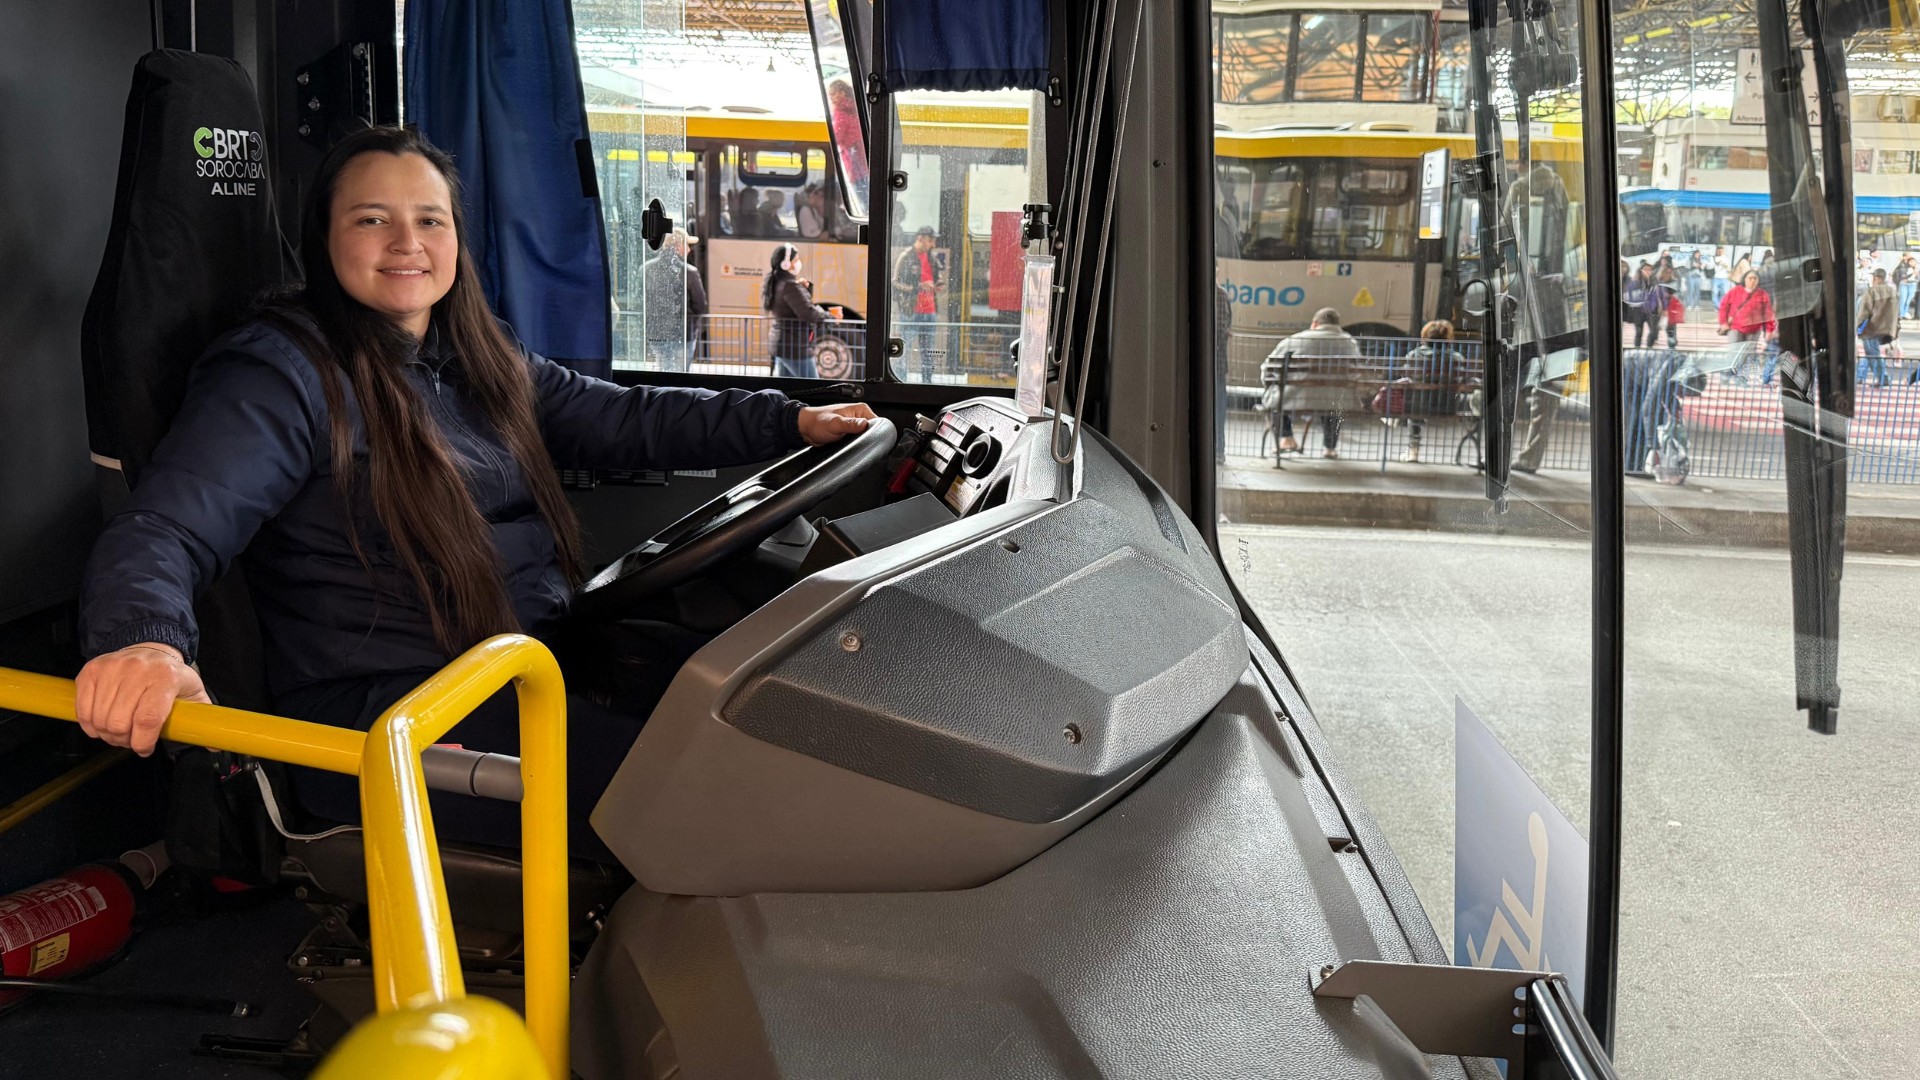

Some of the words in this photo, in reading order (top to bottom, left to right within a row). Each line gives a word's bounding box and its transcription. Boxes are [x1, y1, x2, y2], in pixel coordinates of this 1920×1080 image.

[213, 127, 249, 160] BRT
[196, 158, 265, 179] SOROCABA
[211, 181, 256, 196] ALINE
[1220, 277, 1305, 306] bano
